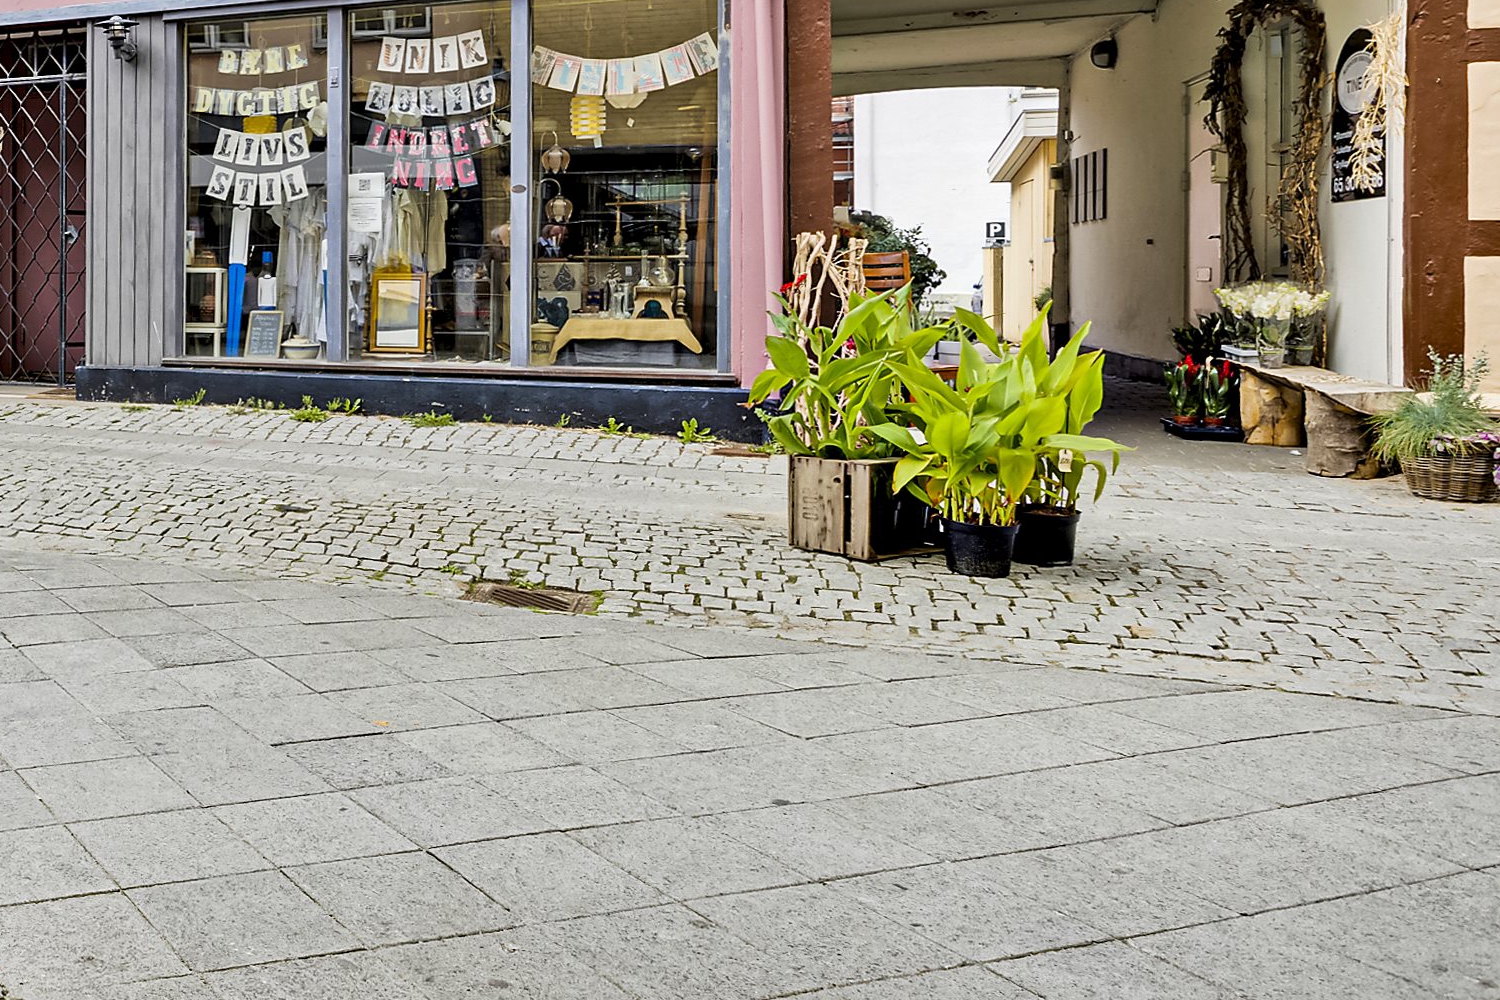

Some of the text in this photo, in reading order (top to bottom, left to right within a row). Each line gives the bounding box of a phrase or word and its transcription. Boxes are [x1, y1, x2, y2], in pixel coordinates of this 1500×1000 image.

[384, 36, 485, 70] UNIK
[1346, 75, 1362, 94] TINE
[217, 132, 305, 162] LIVS
[367, 119, 491, 158] INDRET
[210, 172, 303, 202] STIL
[1334, 177, 1343, 193] 65
[989, 223, 1002, 237] P
